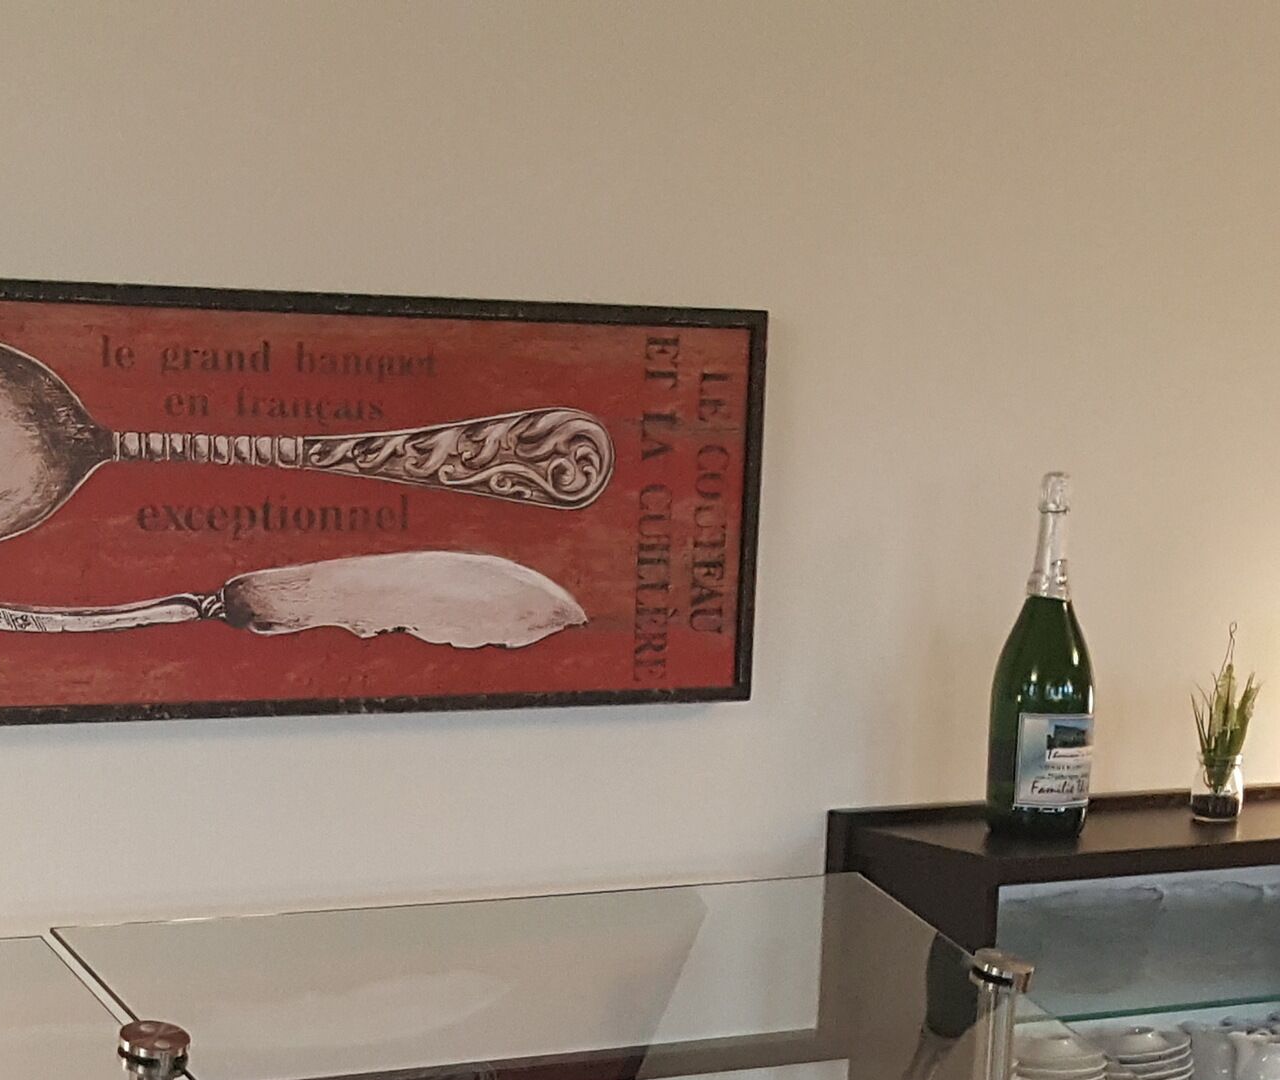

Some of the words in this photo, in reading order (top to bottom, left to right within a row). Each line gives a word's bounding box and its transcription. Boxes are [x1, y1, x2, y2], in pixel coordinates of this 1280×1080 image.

[100, 334, 136, 369] le
[160, 339, 271, 376] grand
[295, 340, 439, 382] banquet
[644, 334, 680, 391] ET
[164, 389, 210, 417] en
[235, 384, 385, 427] français
[698, 372, 732, 422] LE
[640, 410, 679, 461] LA
[136, 493, 410, 541] exceptionnel
[689, 444, 729, 635] COUTEAU
